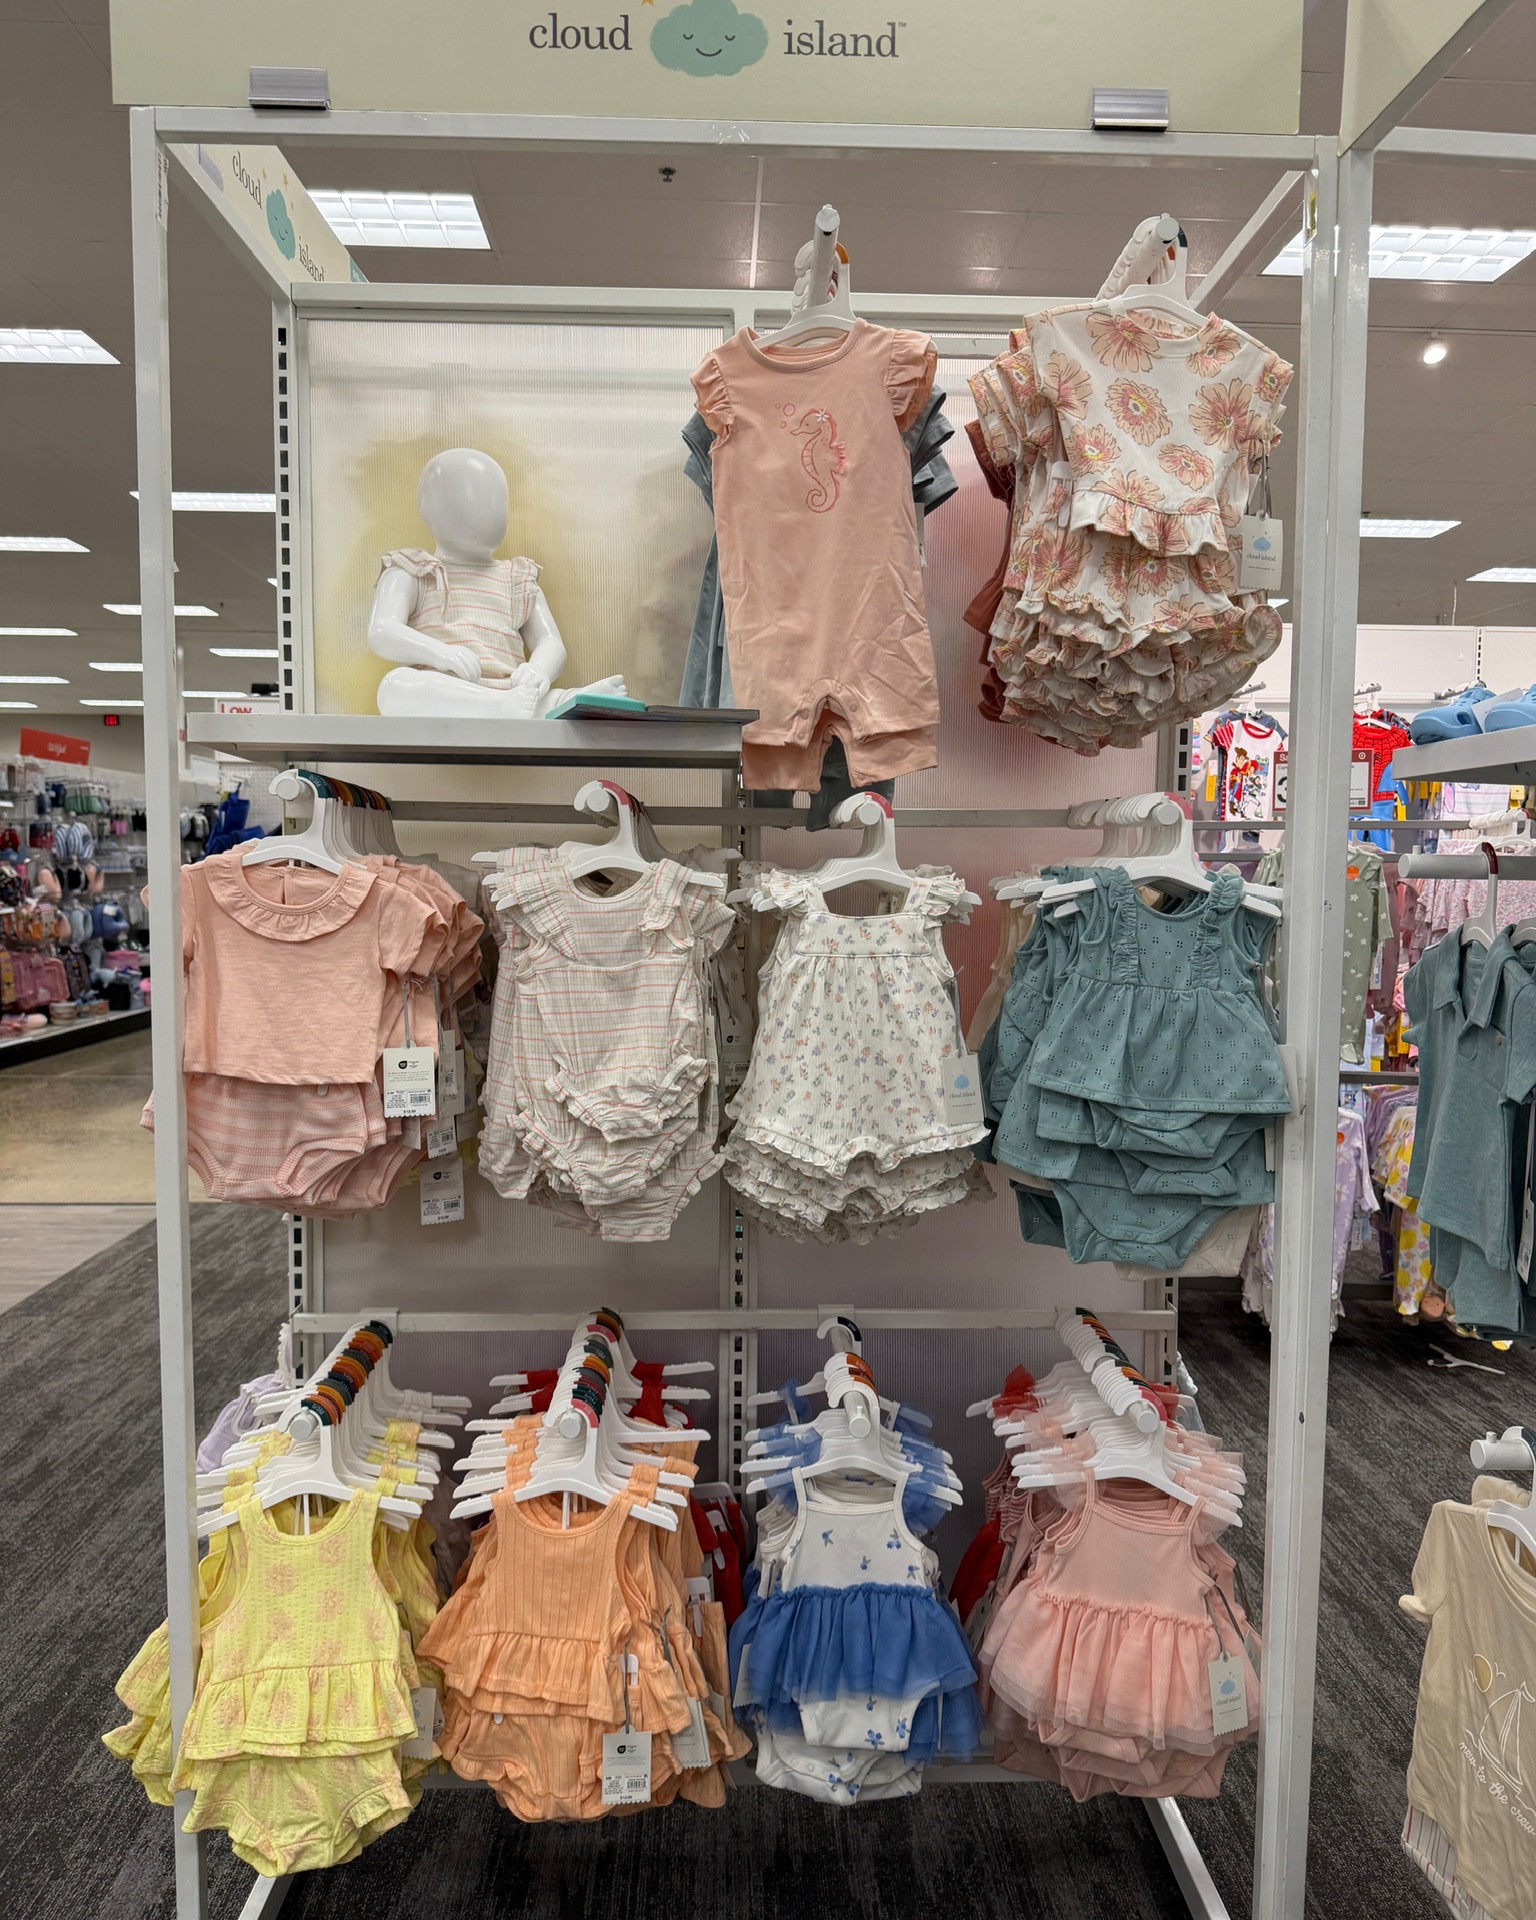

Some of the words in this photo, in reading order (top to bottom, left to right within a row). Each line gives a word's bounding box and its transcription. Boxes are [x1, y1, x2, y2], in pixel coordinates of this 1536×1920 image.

[528, 12, 633, 51] cloud
[231, 150, 263, 210] cloud
[298, 235, 326, 282] island
[1458, 1741, 1477, 1768] new
[1476, 1765, 1487, 1785] to
[1488, 1781, 1509, 1806] the
[1510, 1806, 1536, 1836] crew
